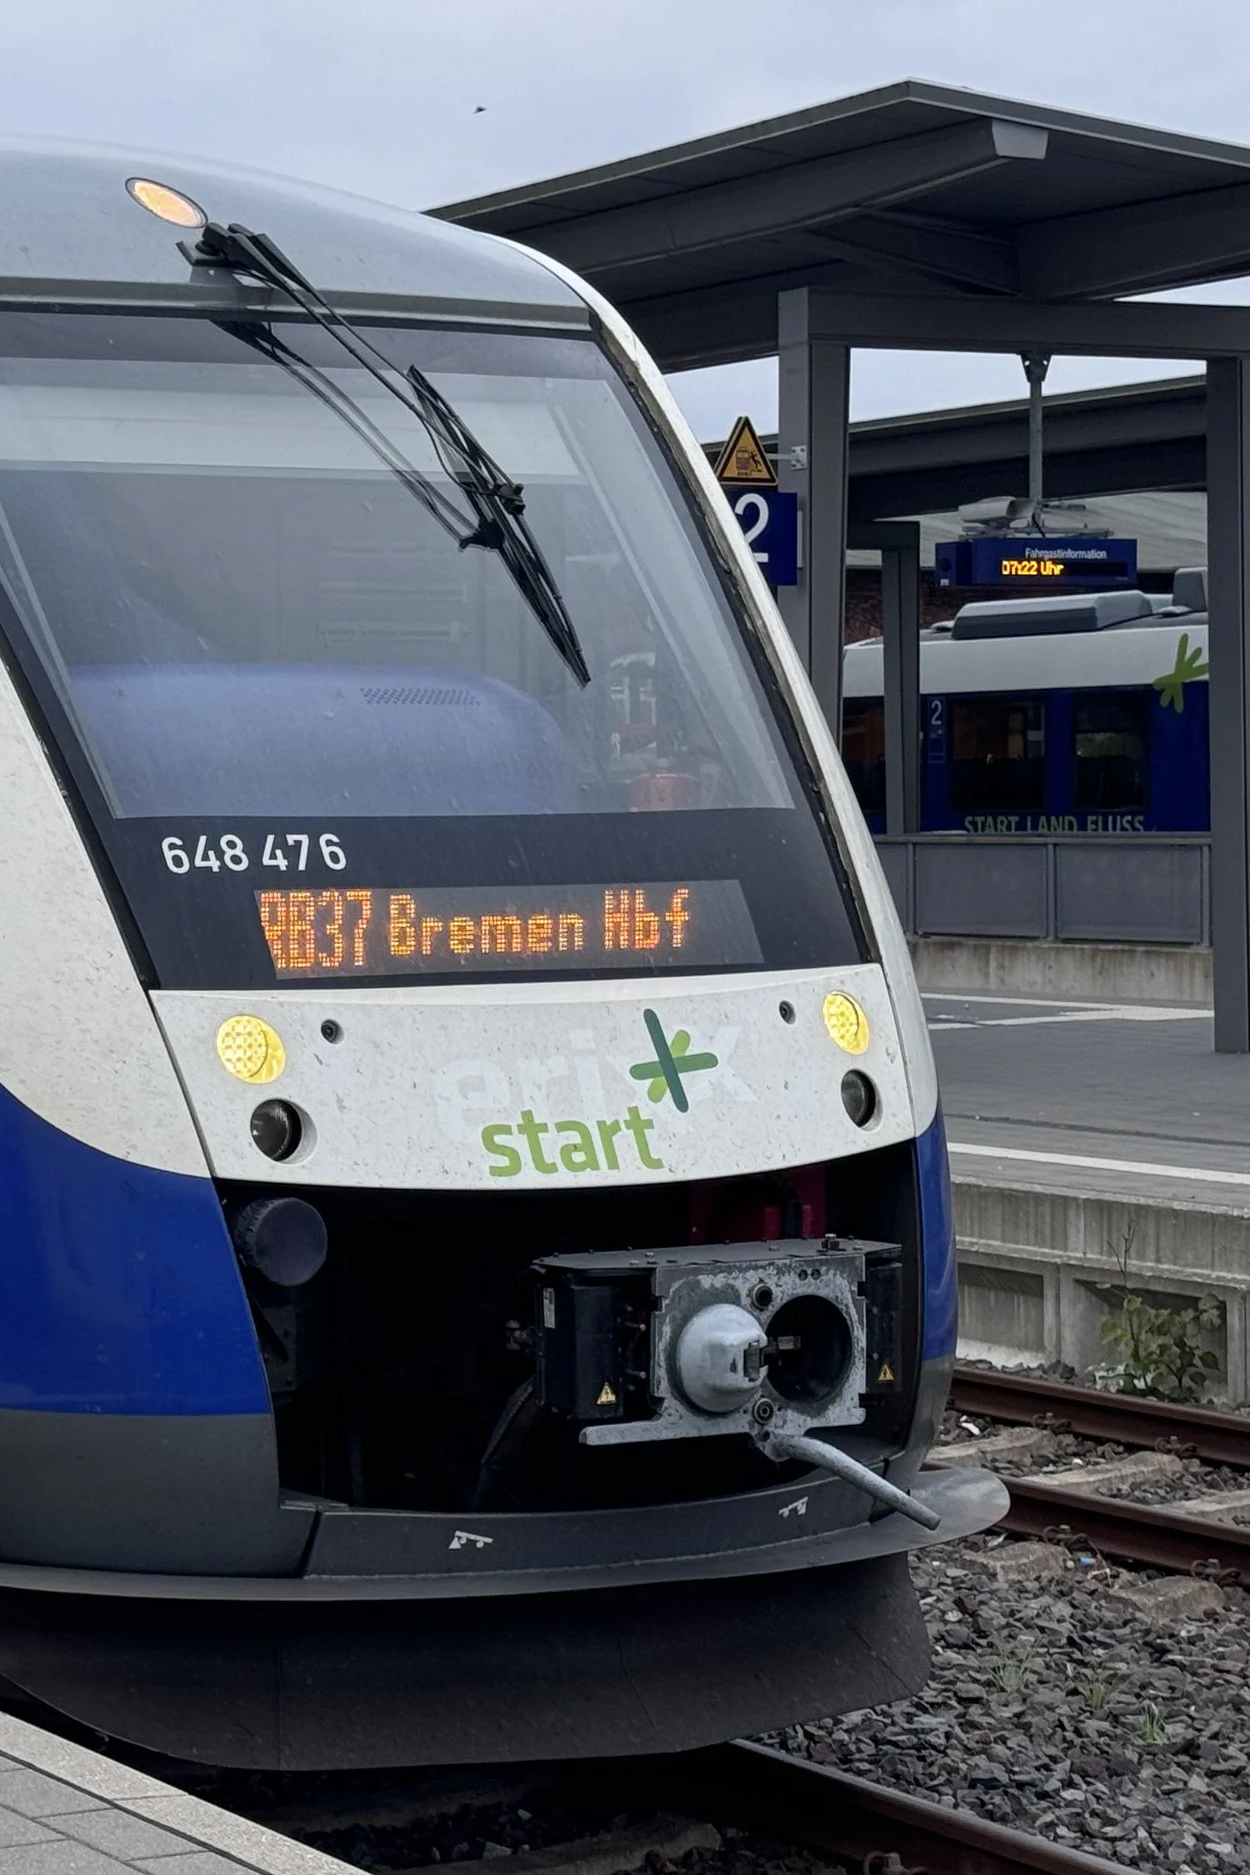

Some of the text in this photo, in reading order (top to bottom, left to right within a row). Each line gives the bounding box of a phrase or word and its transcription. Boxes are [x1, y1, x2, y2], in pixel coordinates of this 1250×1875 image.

[734, 493, 769, 562] 2
[1024, 547, 1108, 561] Fahrgastinformation
[1040, 561, 1064, 576] Uhr
[931, 700, 942, 725] 2
[161, 833, 347, 874] 648 476
[260, 888, 689, 968] RB37 Bremen Hbf
[481, 1105, 664, 1177] start
